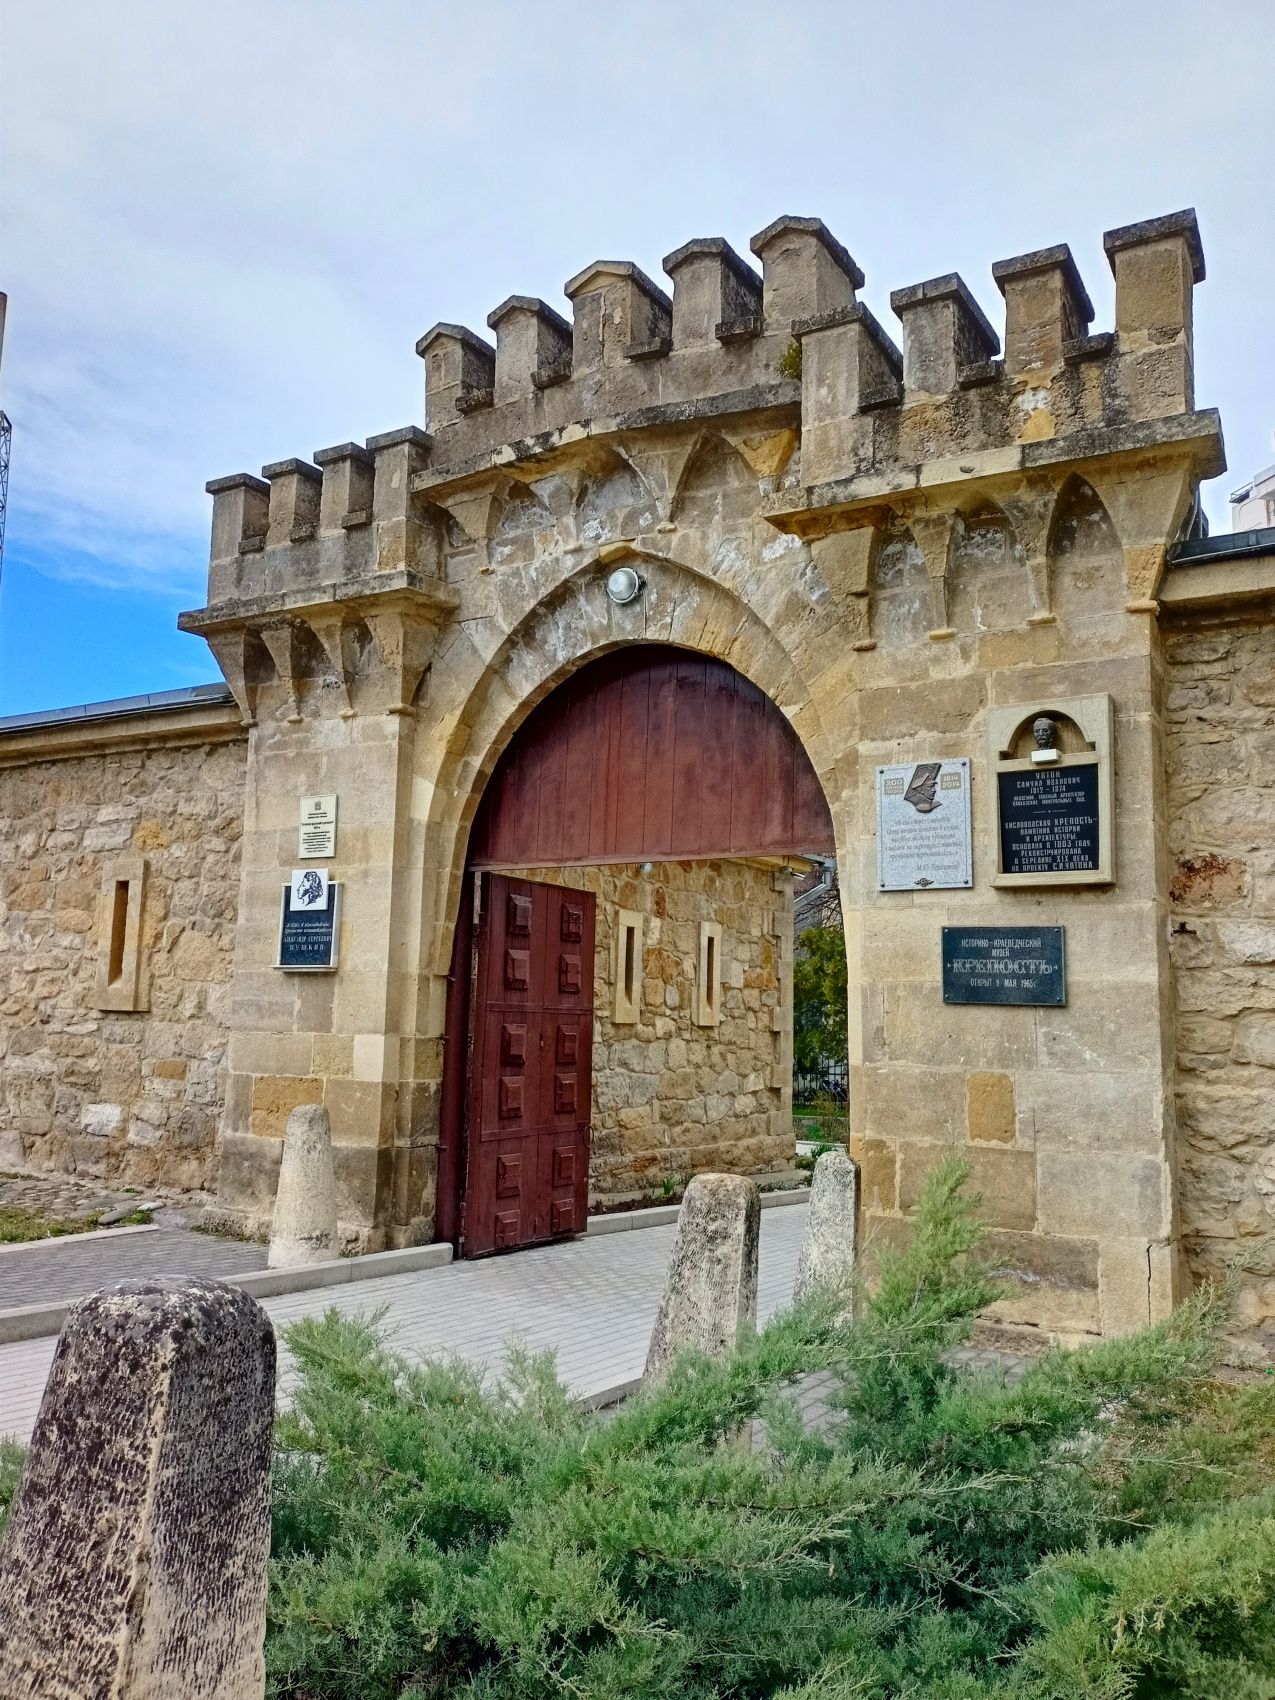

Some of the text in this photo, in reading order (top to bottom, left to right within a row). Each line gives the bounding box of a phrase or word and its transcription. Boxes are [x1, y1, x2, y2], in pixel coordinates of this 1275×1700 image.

[1005, 820, 1051, 829] КИСЛОВОДСКАЯ
[1020, 828, 1051, 836] ПАМЯТНИК
[991, 948, 1010, 957] МУЗЕЙ
[970, 979, 993, 987] ОТКРЫТ
[995, 979, 1000, 987] 9
[1004, 979, 1017, 988] МАЯ
